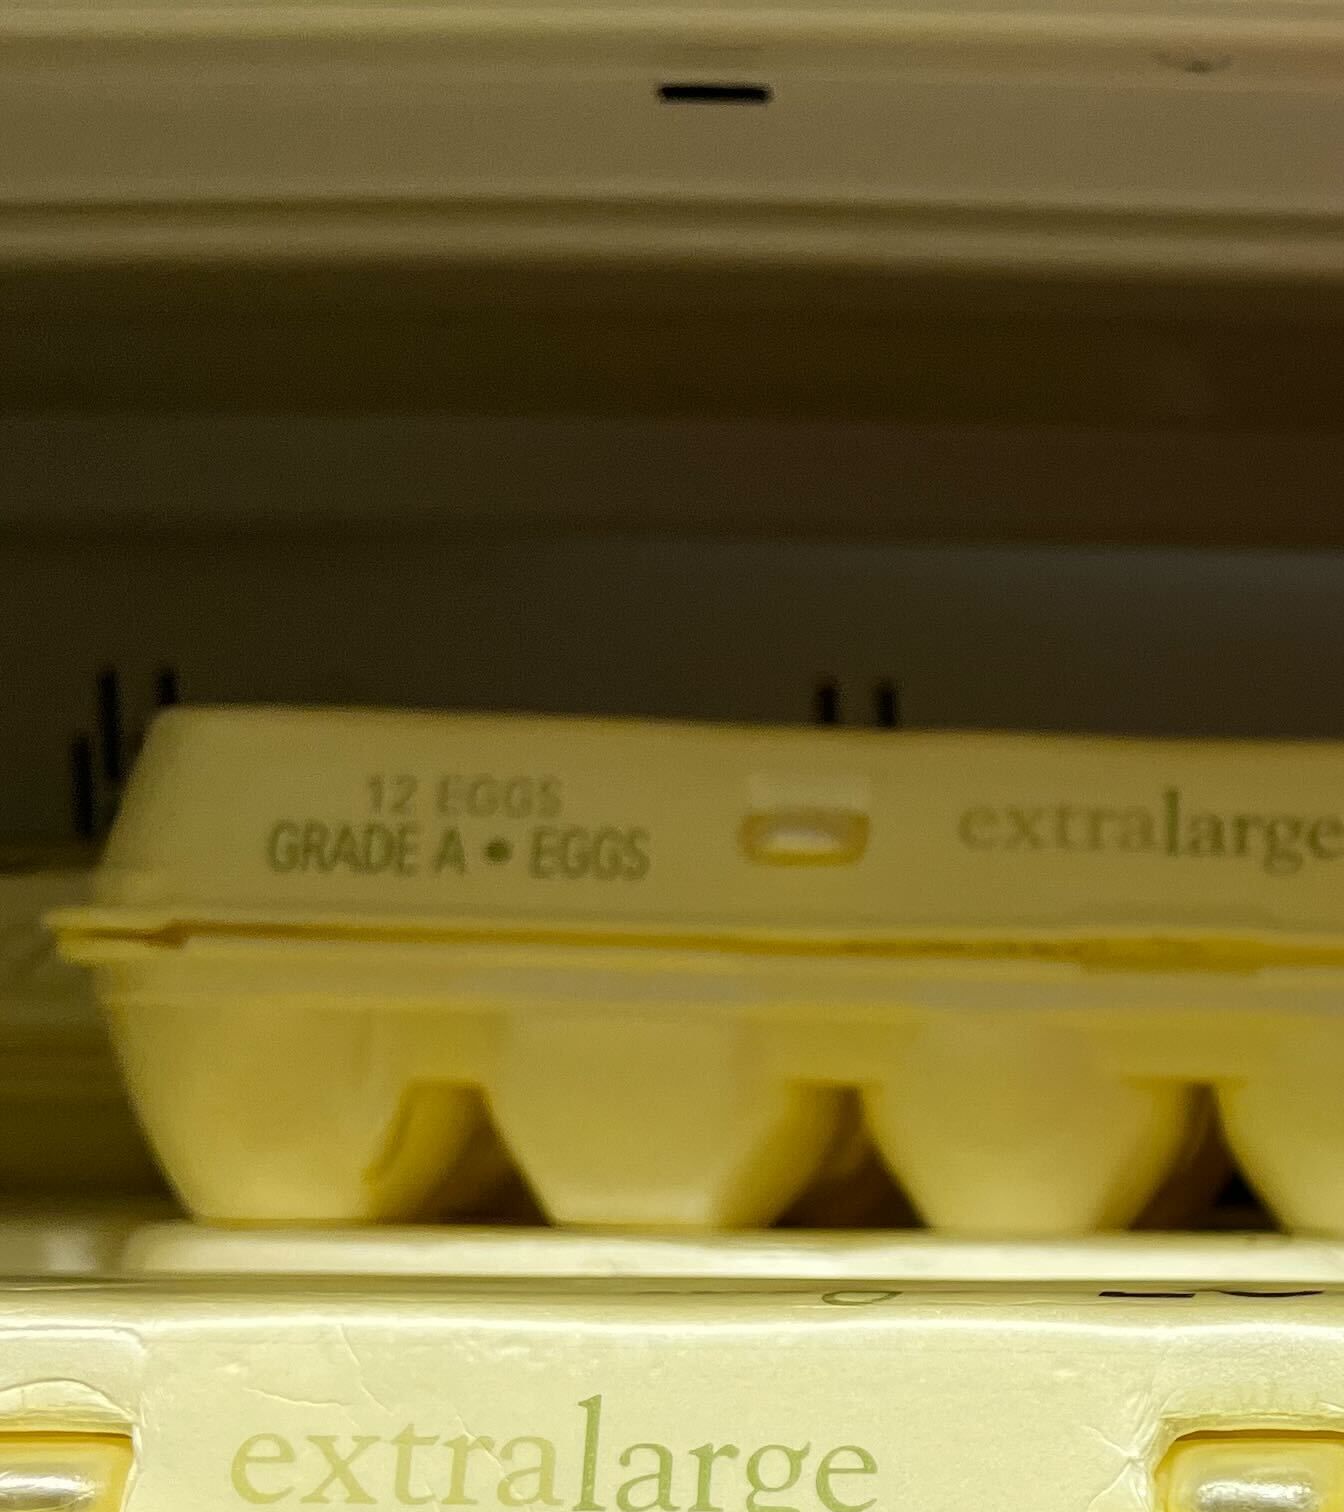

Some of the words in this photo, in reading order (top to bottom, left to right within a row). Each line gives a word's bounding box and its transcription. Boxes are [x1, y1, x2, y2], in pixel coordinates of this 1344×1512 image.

[367, 774, 418, 816] 12
[436, 774, 563, 819] EGGS
[266, 819, 419, 877] GRADE
[433, 825, 467, 877] A
[530, 825, 651, 880] EGGS
